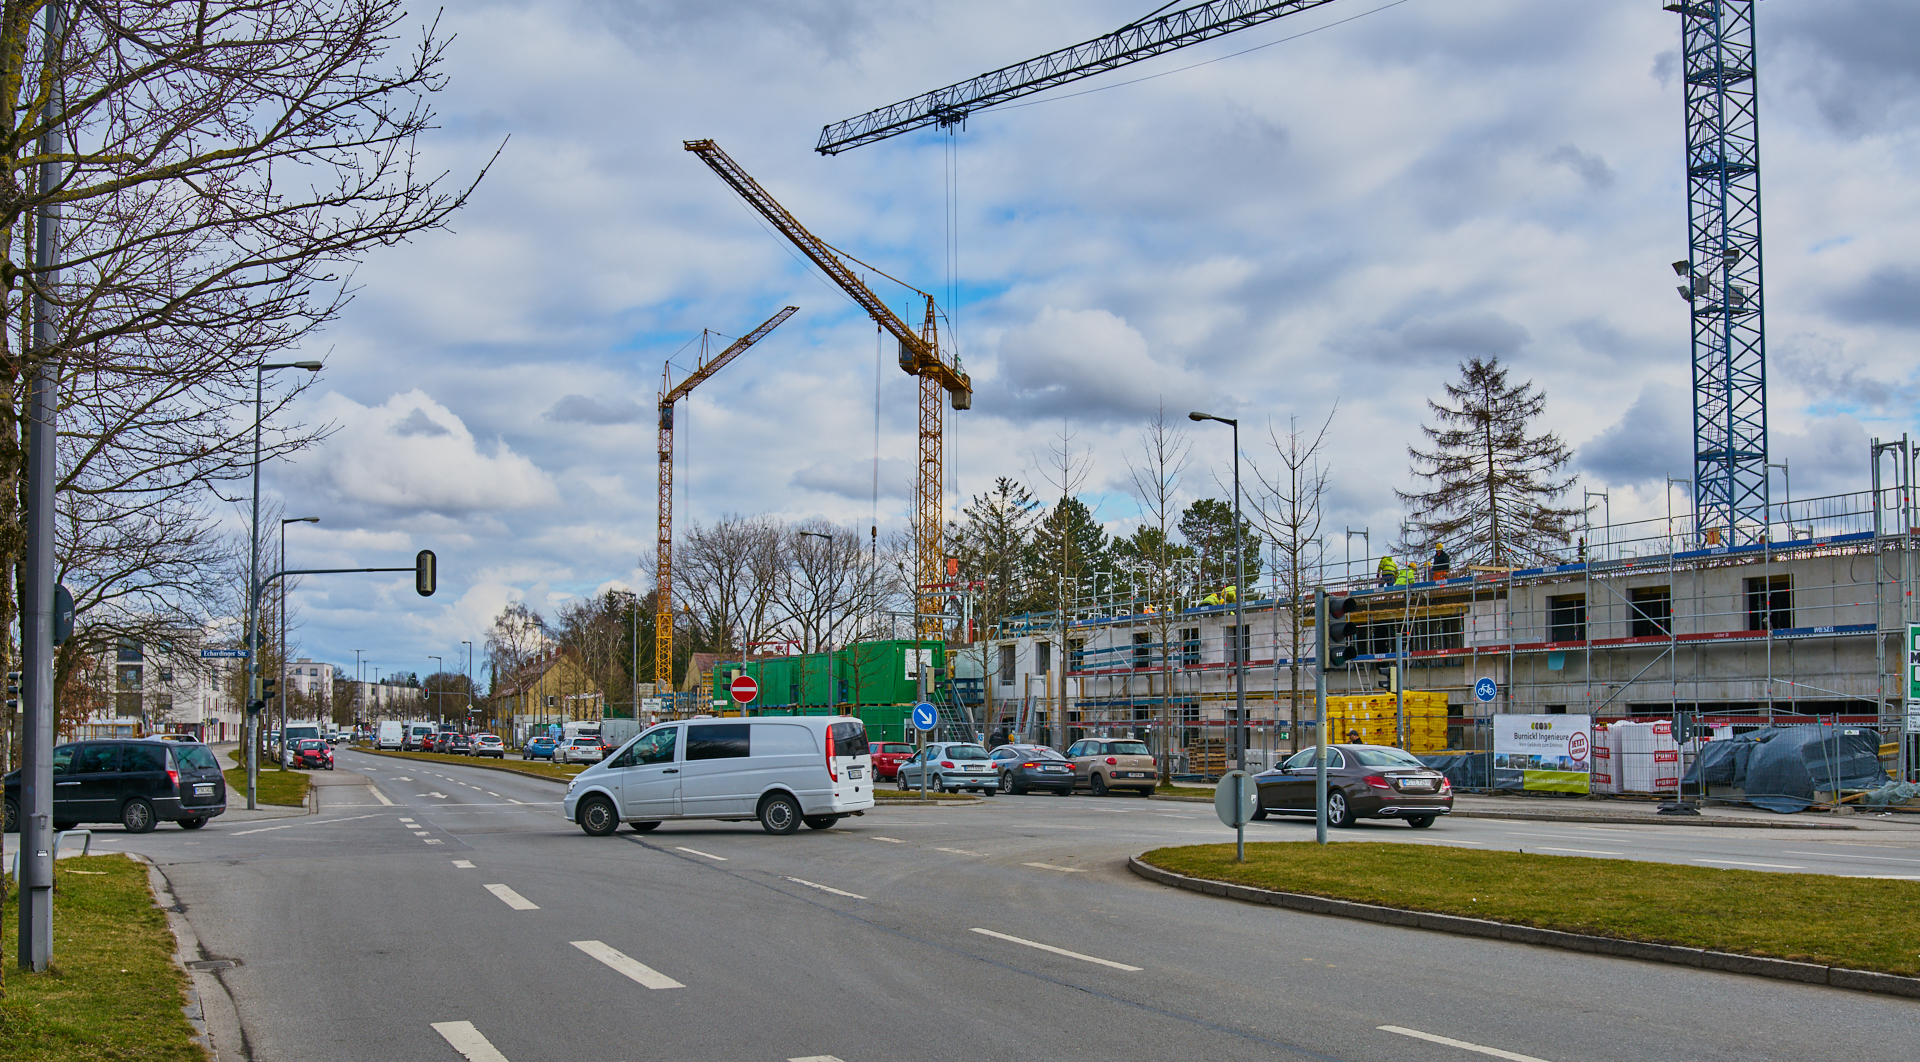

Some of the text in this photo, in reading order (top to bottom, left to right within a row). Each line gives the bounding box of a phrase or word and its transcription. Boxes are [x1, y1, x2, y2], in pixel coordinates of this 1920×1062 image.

[1710, 547, 1729, 555] WIESER
[1813, 626, 1834, 634] WIESER
[1514, 732, 1569, 742] Burnickl Ingenieure
[1571, 738, 1585, 749] JETZT
